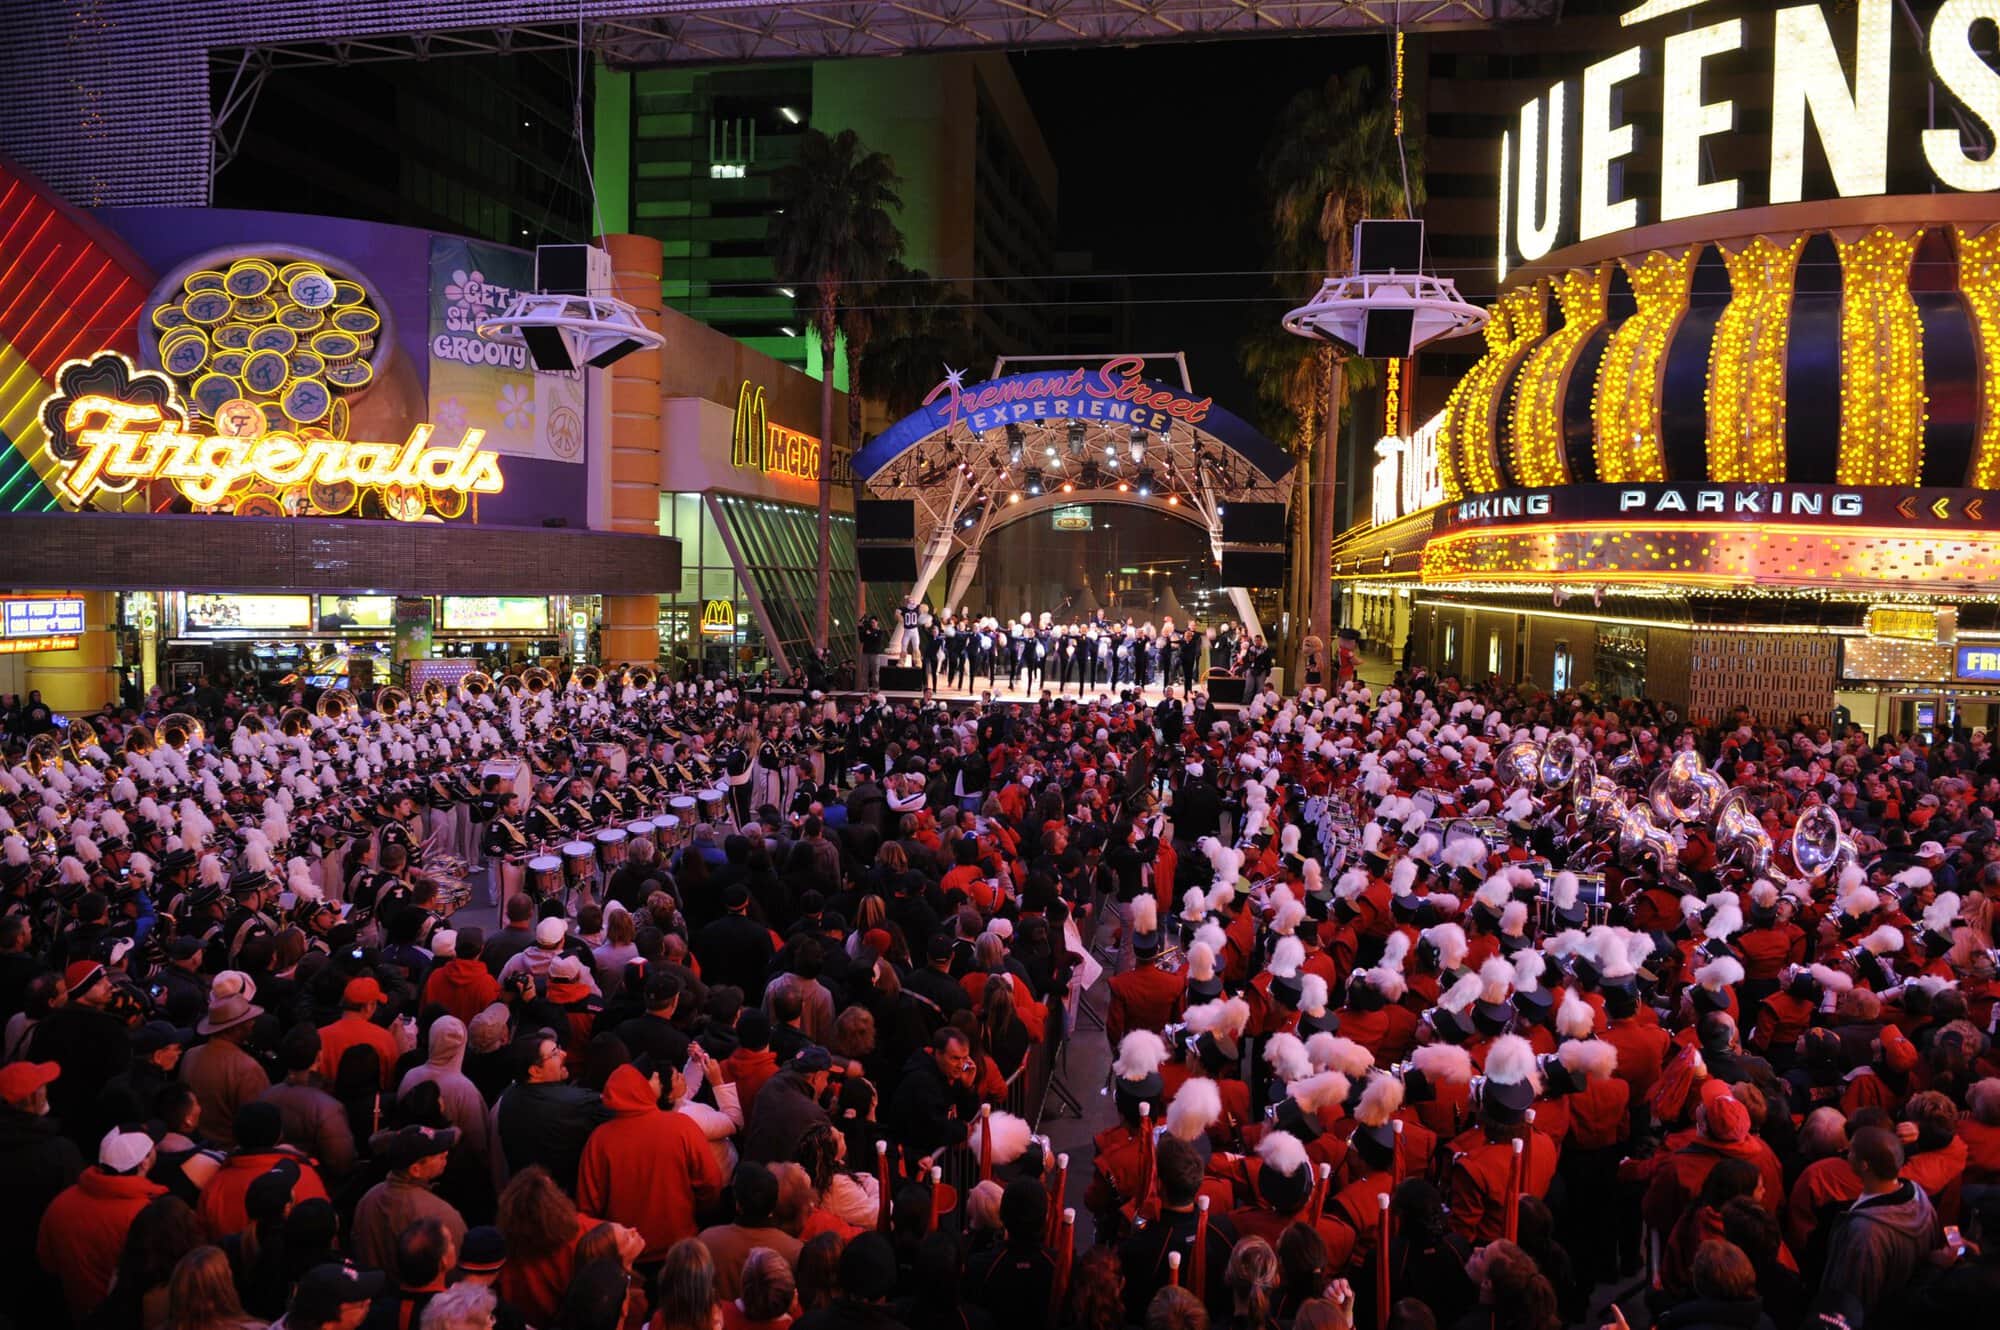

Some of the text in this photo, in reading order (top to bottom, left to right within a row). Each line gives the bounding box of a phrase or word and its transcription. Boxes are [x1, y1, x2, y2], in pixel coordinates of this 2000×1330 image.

[1499, 0, 2000, 283] UEENS
[463, 281, 510, 309] GET
[432, 334, 527, 371] GROOVY
[922, 356, 1213, 436] Fremont Street
[1386, 357, 1400, 437] NTRANCE
[973, 399, 1166, 430] EXPERIENCE
[1620, 490, 1863, 517] PARKING
[904, 612, 918, 625] 00
[1967, 652, 2000, 671] FR
